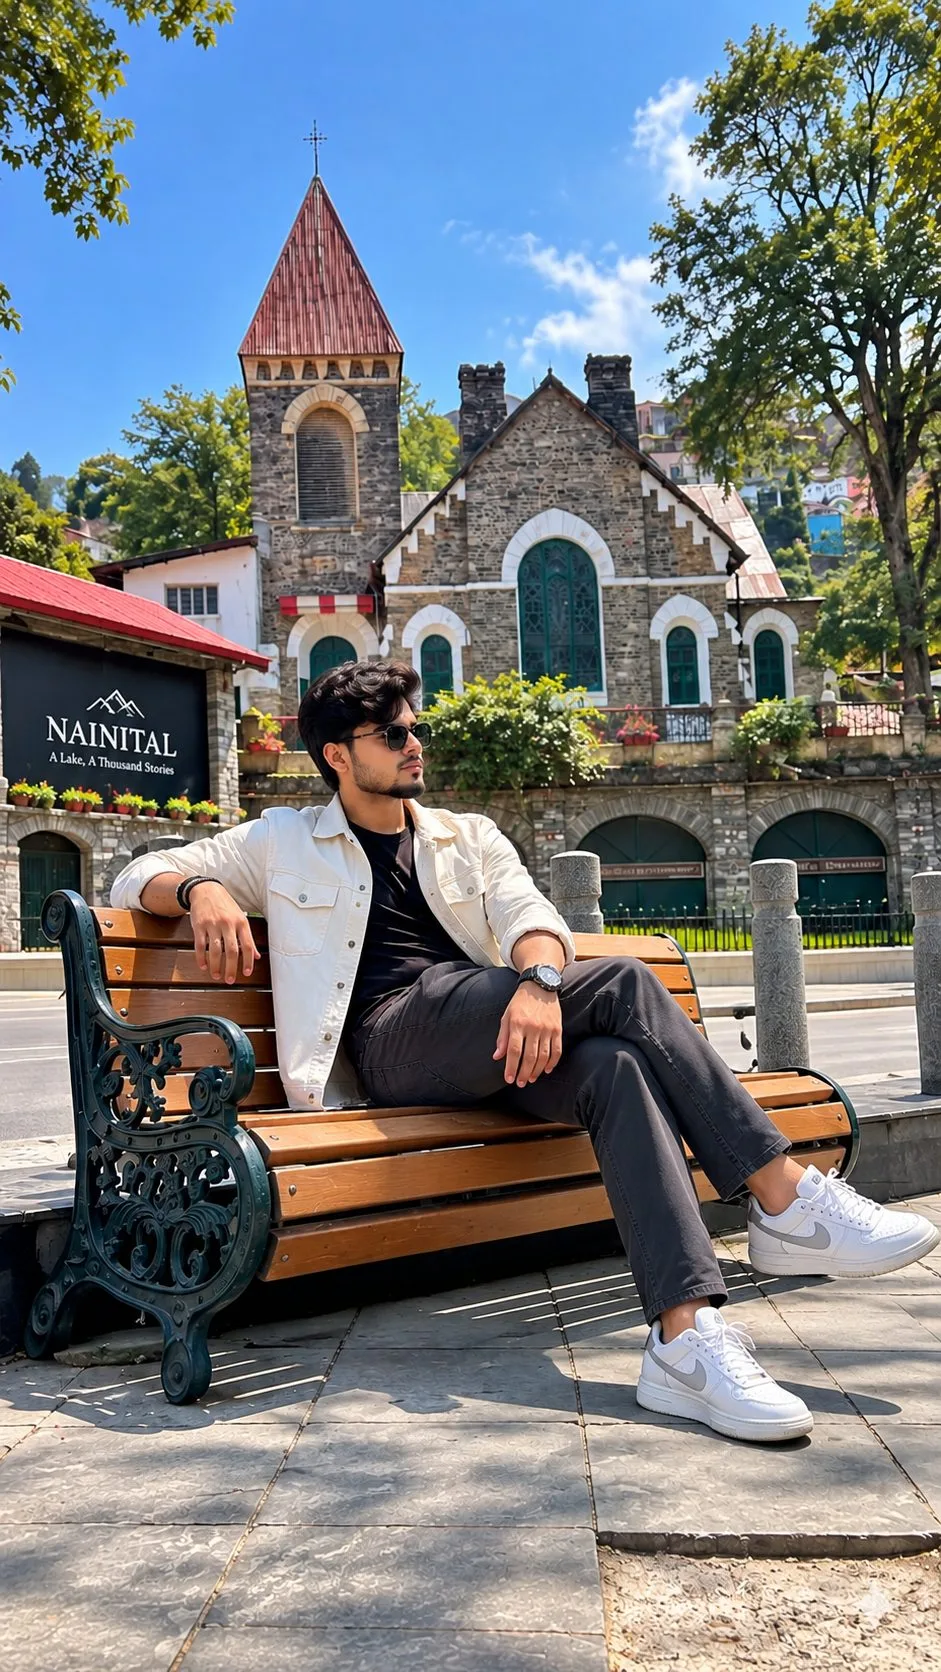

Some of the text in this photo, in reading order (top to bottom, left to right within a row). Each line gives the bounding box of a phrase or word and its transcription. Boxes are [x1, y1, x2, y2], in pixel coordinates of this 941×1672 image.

[46, 715, 178, 758] NAINITAL
[49, 751, 175, 775] A Lake, A Thousand Stories
